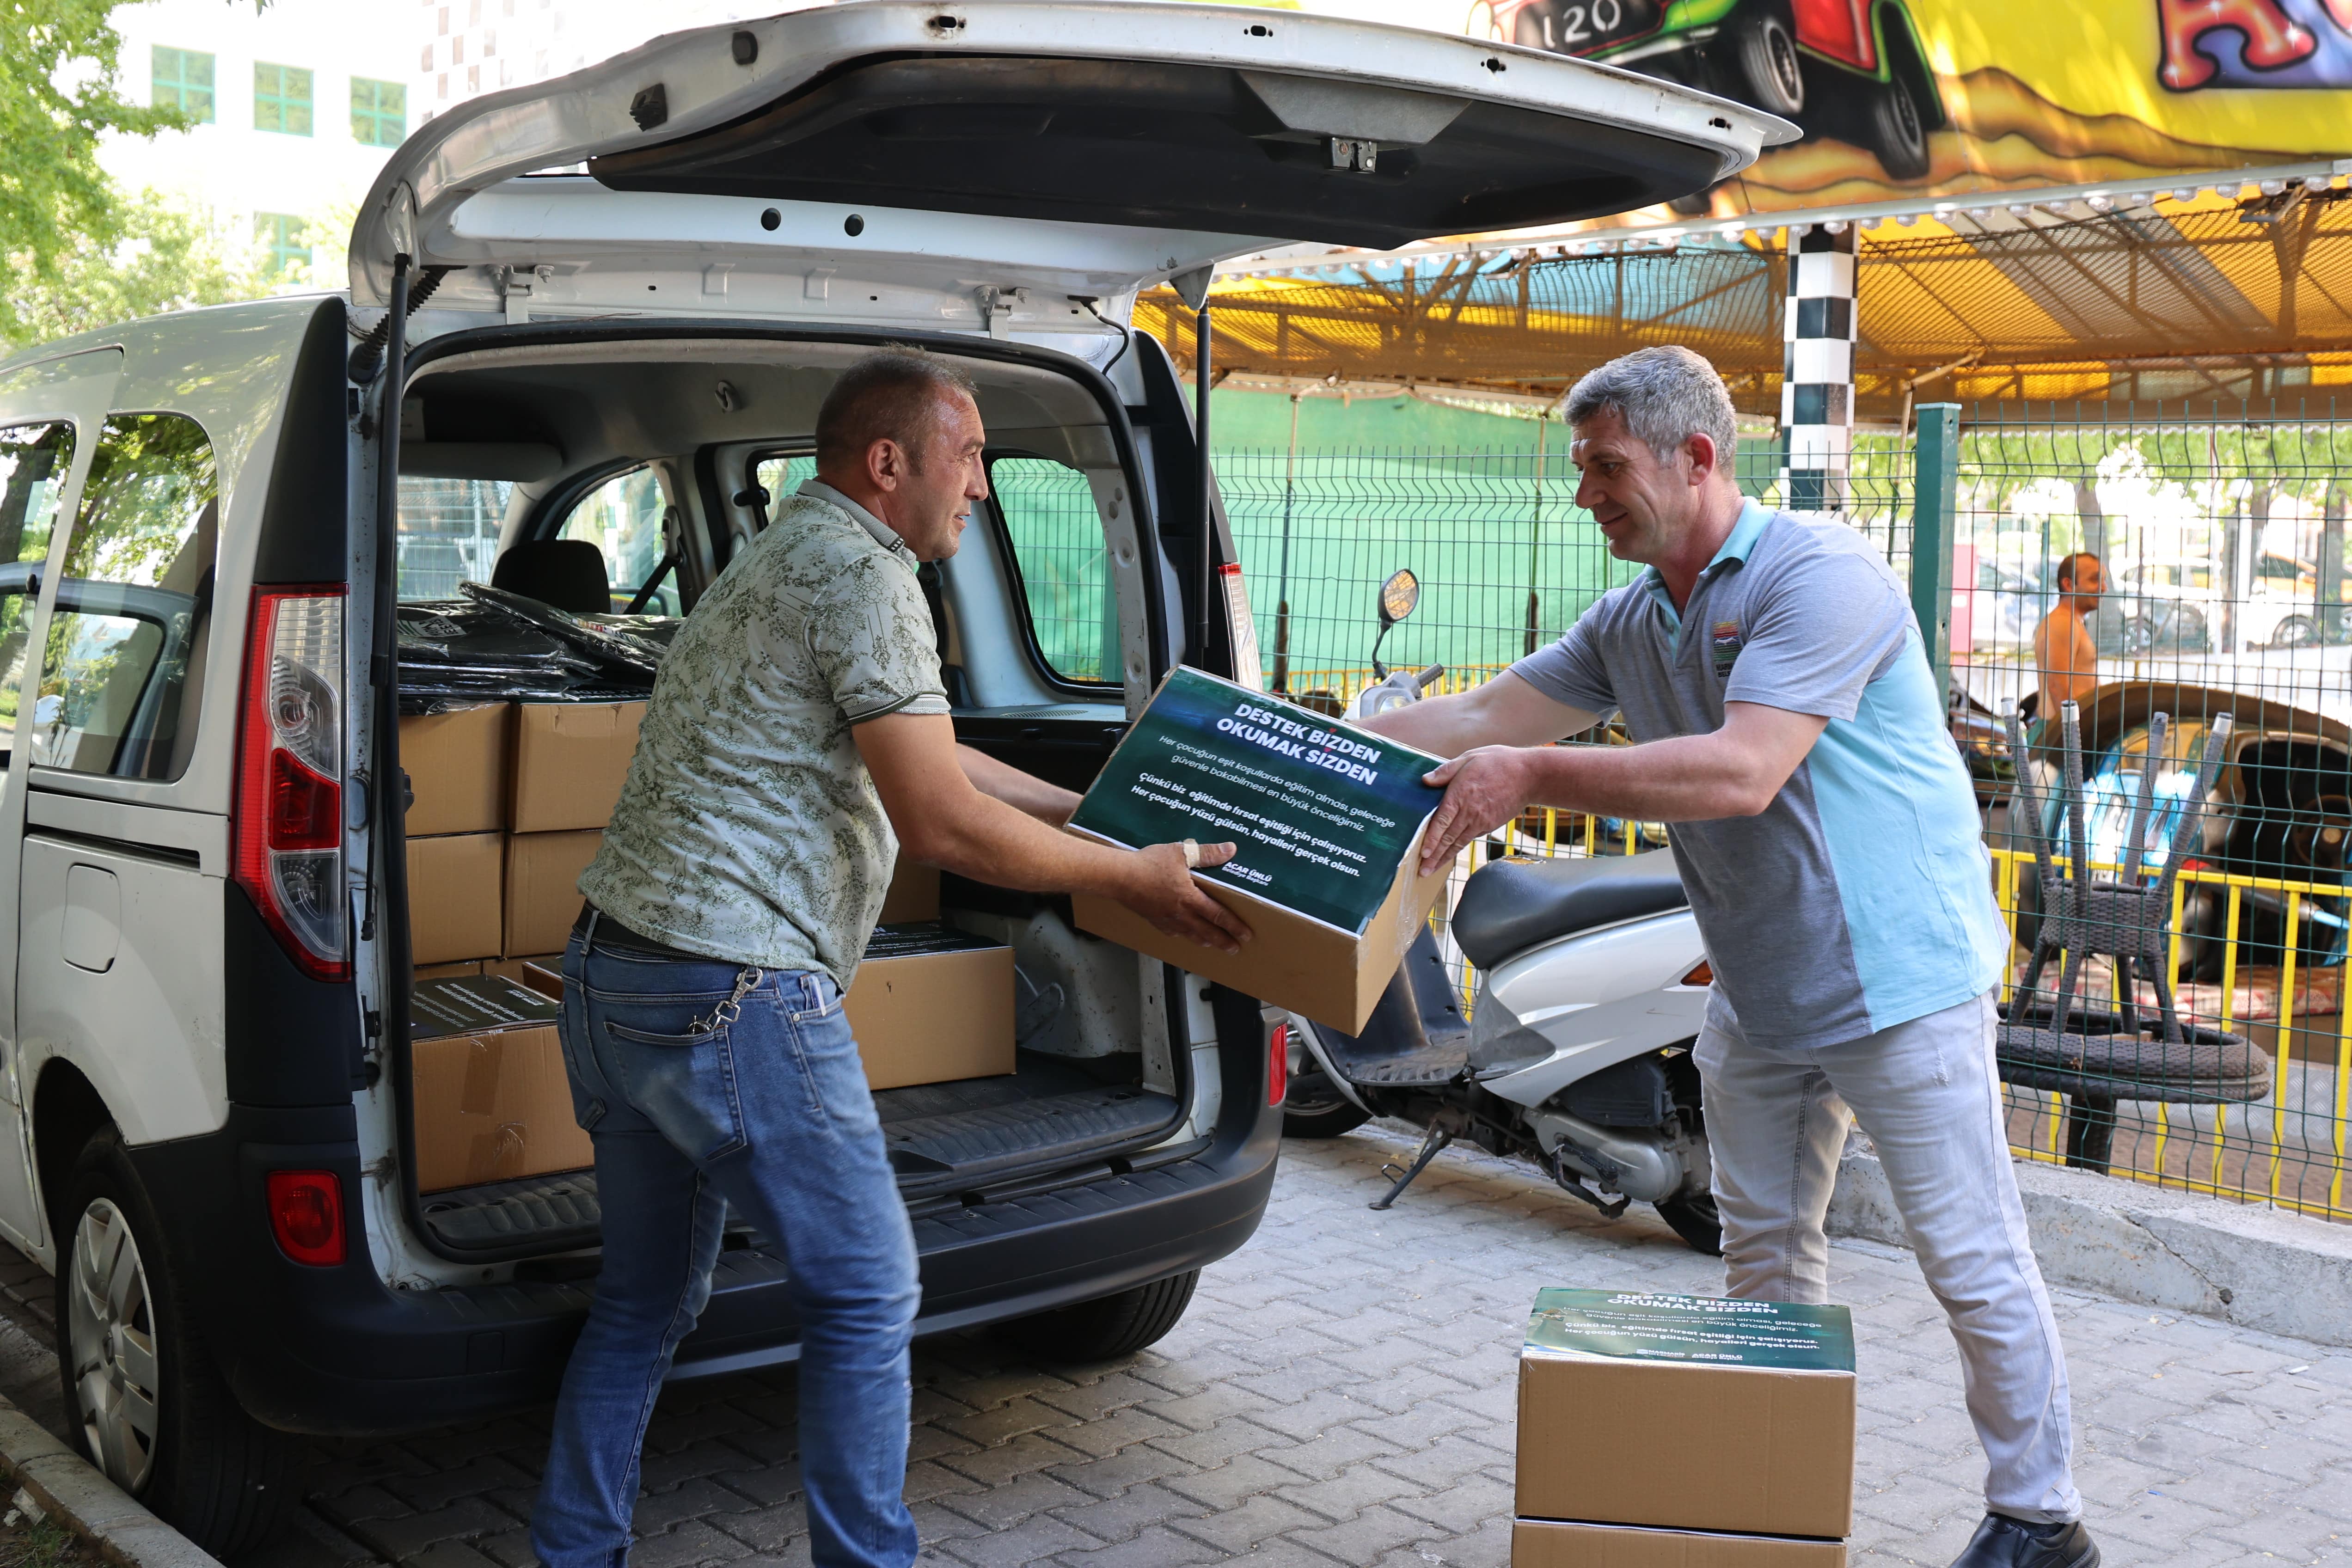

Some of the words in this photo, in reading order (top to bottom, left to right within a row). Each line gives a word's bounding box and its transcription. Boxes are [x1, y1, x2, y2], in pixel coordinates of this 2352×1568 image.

[1217, 718, 1307, 759] OKUMAK
[1305, 747, 1378, 785] SİZDEN
[1234, 704, 1310, 739] DESTEK
[1307, 728, 1382, 764] BİZDEN
[1158, 735, 1177, 746] Her
[1176, 743, 1217, 760] çocuğun
[1218, 758, 1236, 767] eşit
[1235, 762, 1284, 784] koşullarda
[1284, 781, 1315, 797] eğitim
[1315, 794, 1349, 812] alması,
[1349, 808, 1396, 827] geleceğe
[1170, 755, 1209, 772] güvenle
[1209, 767, 1268, 793] bakabilmesi
[1267, 790, 1280, 798] en
[1280, 793, 1311, 811] büyük
[1310, 806, 1365, 832] önceliğimiz.
[1131, 785, 1150, 796] Her
[1148, 793, 1191, 812] çocuğun
[1189, 808, 1216, 821] yüzü
[1213, 818, 1250, 836] gülsün,
[1251, 829, 1297, 852] hayalleri
[1294, 848, 1331, 865] gerçek
[1330, 861, 1360, 876] olsun.
[1139, 772, 1172, 789] Çünkü
[1170, 783, 1187, 794] biz
[1188, 791, 1232, 811] eğitimde
[1231, 806, 1260, 821] fırsat
[1259, 818, 1294, 835] eşitliği
[1291, 828, 1311, 841] için
[1311, 838, 1366, 863] çalışıyoruz.
[1224, 862, 1250, 874] ACAR
[1247, 869, 1273, 882] ÜNLÜ
[1607, 1298, 1703, 1311] OKUMAK
[1705, 1305, 1778, 1314] SİZDEN
[1617, 1294, 1692, 1304] DESTEK
[1696, 1299, 1770, 1310] BİZDEN
